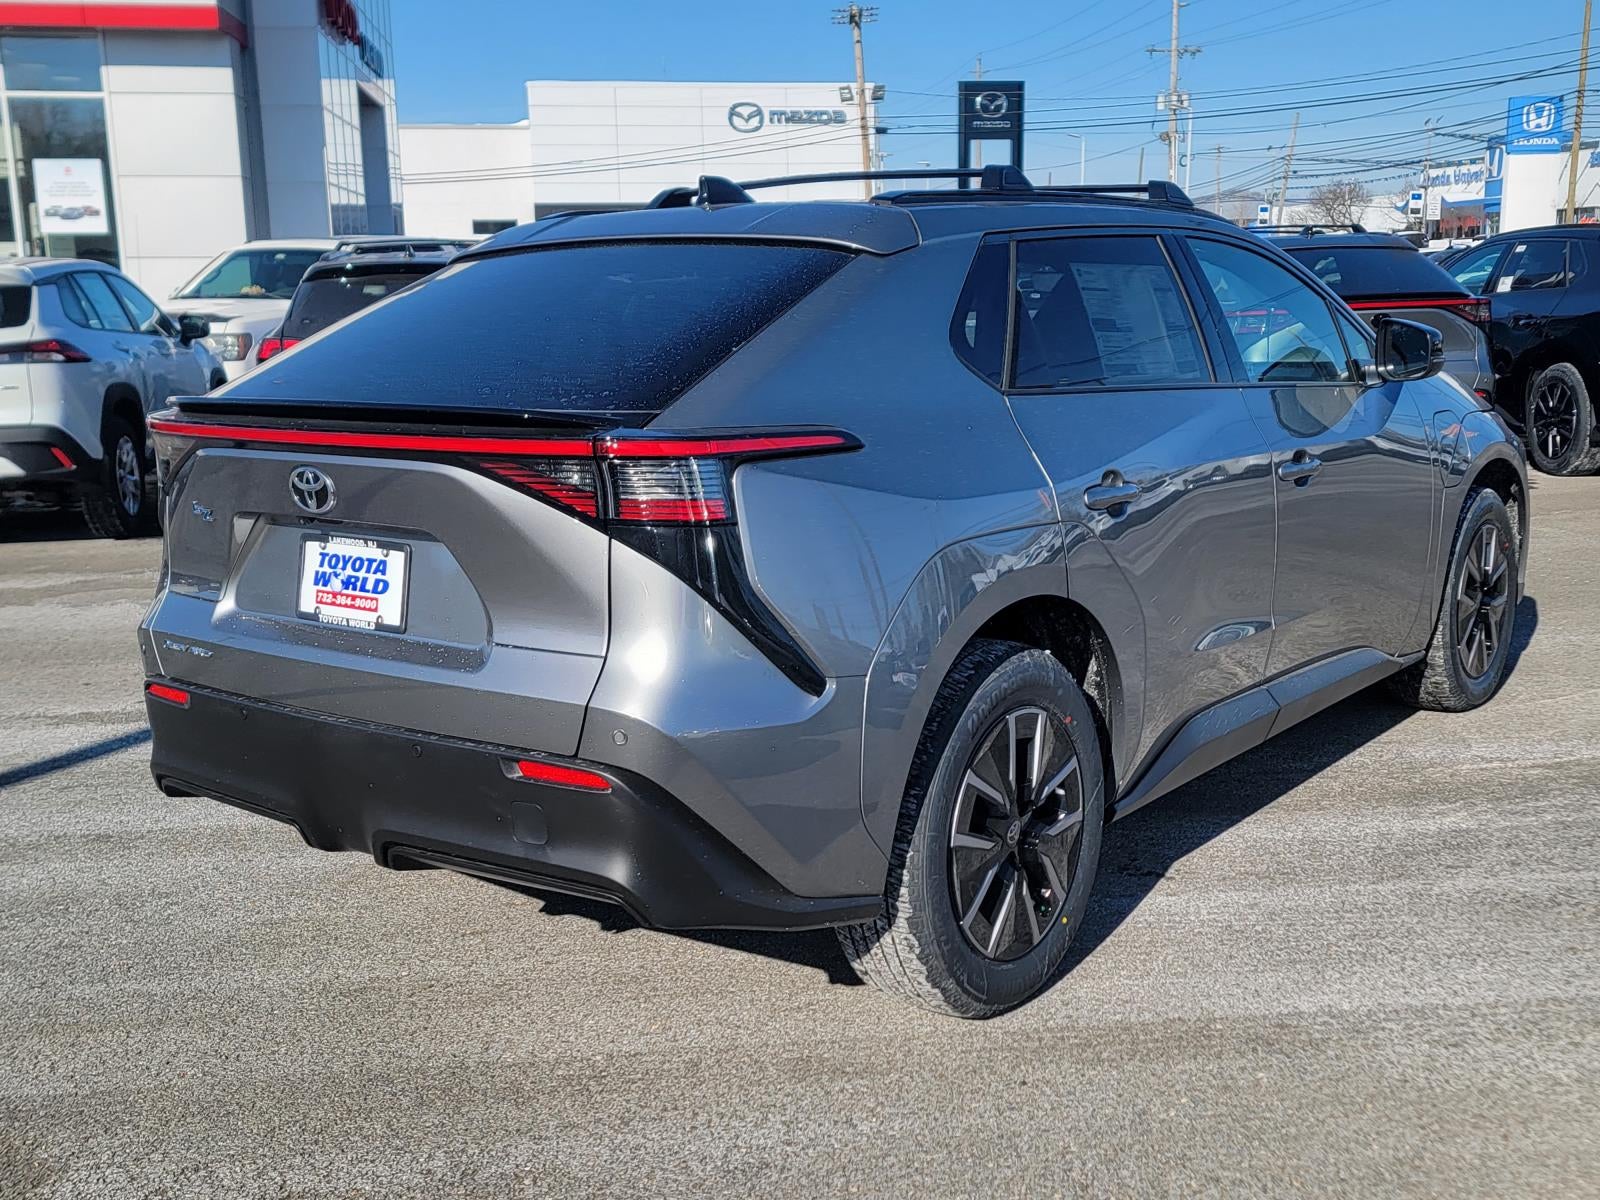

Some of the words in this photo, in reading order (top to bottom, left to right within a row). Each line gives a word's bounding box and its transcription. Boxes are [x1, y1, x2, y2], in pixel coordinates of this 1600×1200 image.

[769, 109, 847, 124] mazda
[1512, 137, 1560, 145] HONDA
[367, 540, 377, 548] NJ
[318, 551, 388, 576] TOYOTA
[317, 592, 377, 609] 732-364-9000
[318, 614, 348, 626] TOYOTA
[348, 618, 376, 630] WORLD
